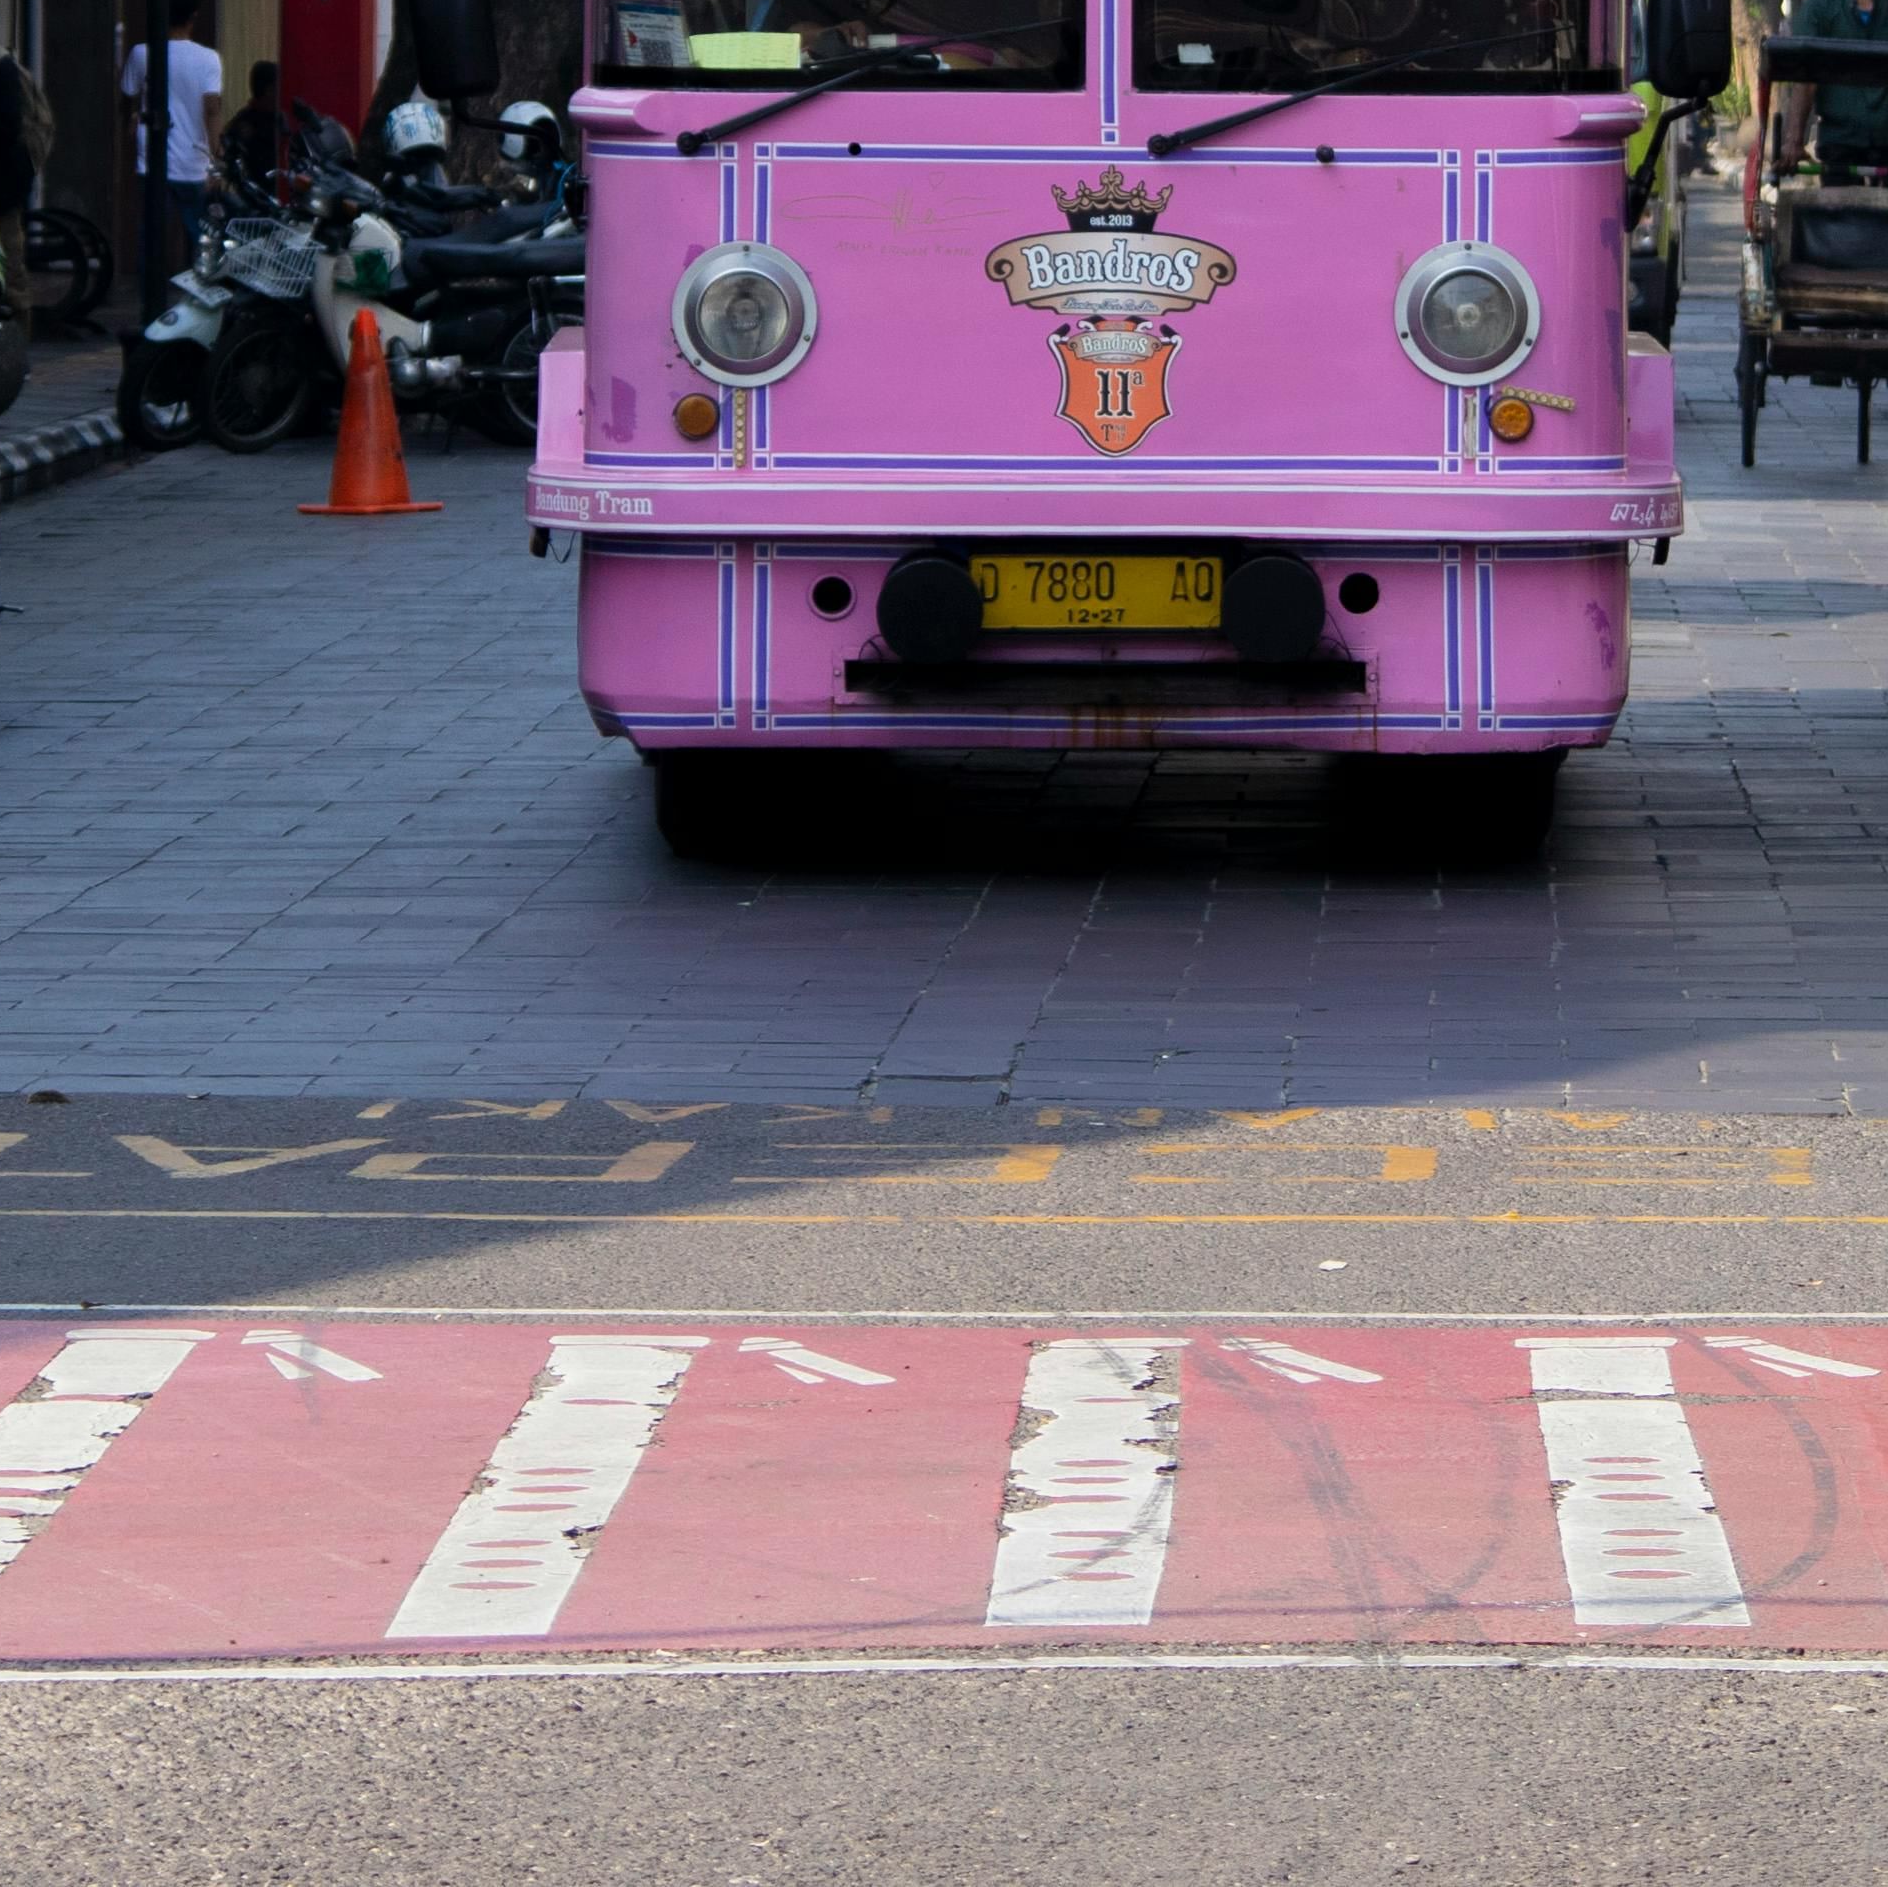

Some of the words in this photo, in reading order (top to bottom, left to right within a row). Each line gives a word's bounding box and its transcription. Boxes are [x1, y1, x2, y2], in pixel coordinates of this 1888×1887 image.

[1020, 237, 1201, 294] Bandros
[1080, 334, 1149, 353] Bandros
[595, 490, 654, 516] Tram
[980, 562, 999, 603] D
[1024, 560, 1116, 603] 7880
